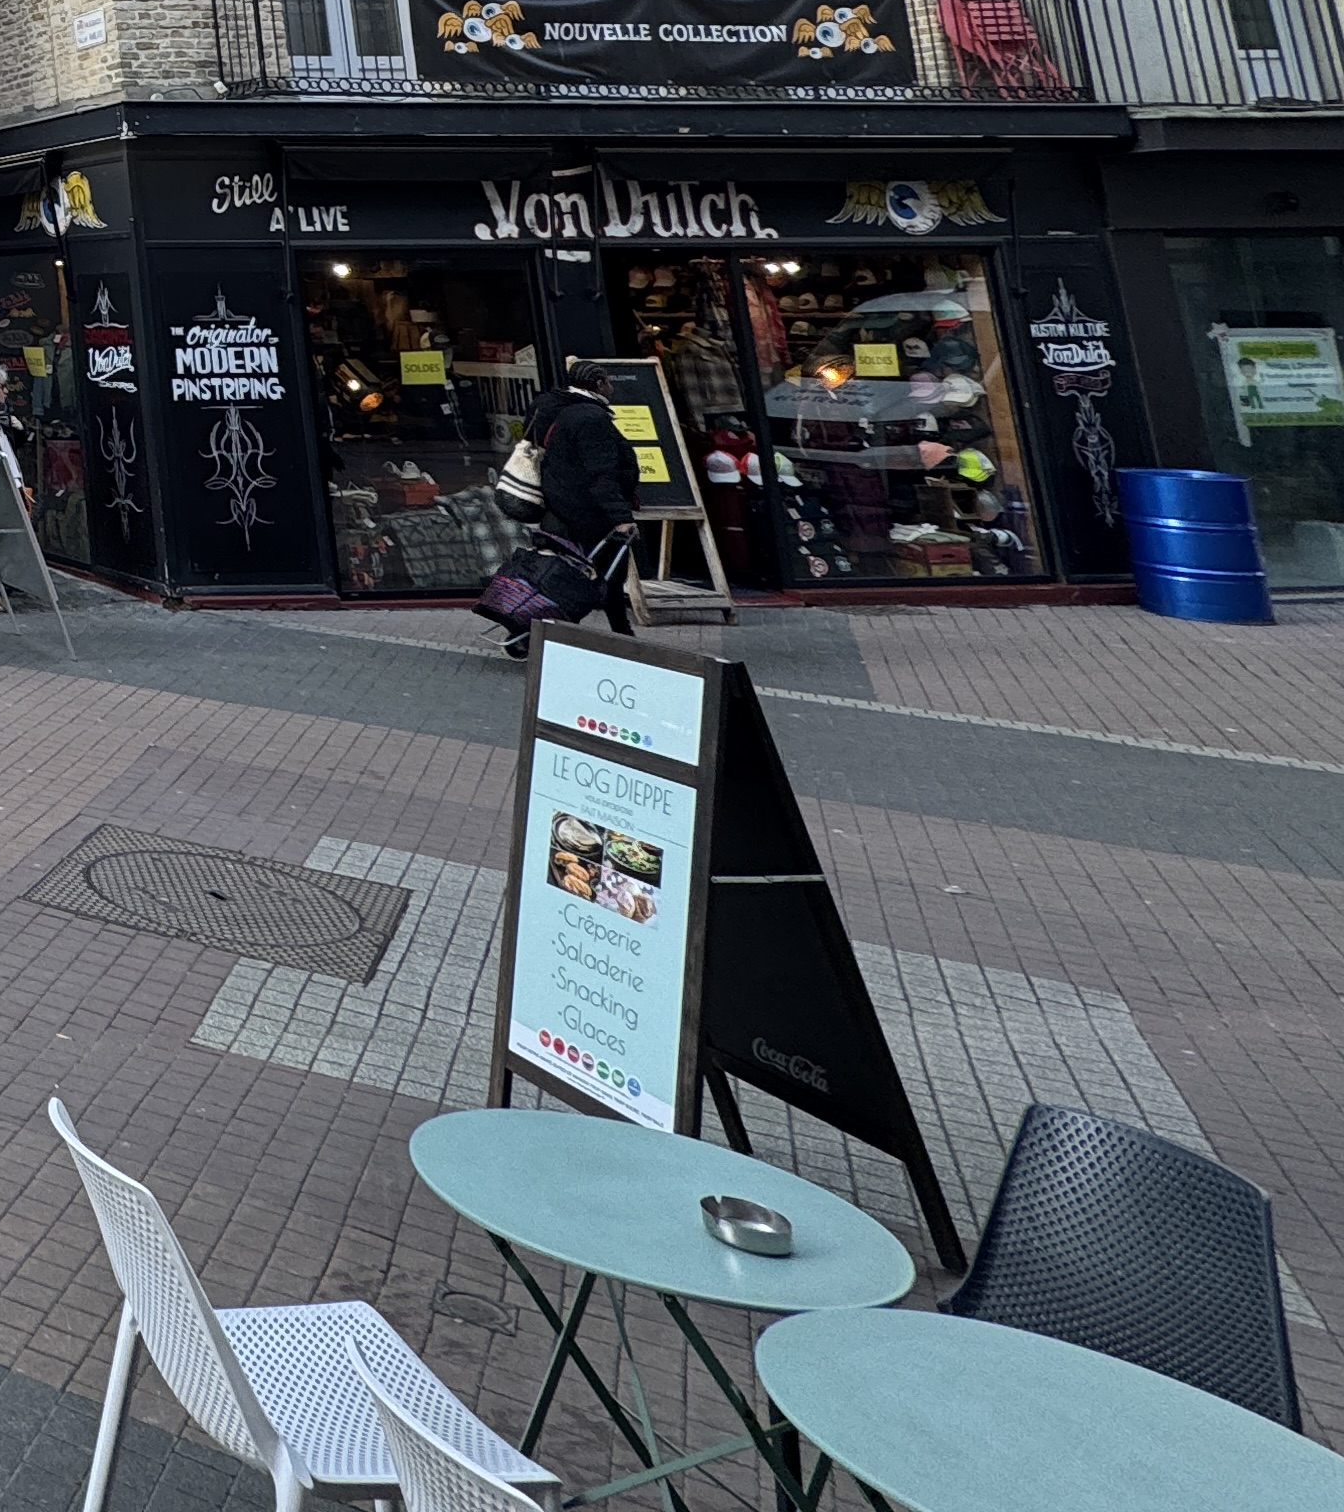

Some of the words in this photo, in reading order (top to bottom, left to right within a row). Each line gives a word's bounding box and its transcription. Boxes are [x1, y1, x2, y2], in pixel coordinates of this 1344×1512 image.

[544, 22, 652, 41] NOUVELLE
[659, 24, 788, 43] COLLECTION
[211, 172, 278, 215] Still
[186, 316, 273, 349] Originator
[175, 346, 279, 375] MODERN
[404, 363, 442, 374] SOLDES
[858, 355, 894, 366] SOLDES
[172, 377, 286, 402] PINSTRIPING
[552, 753, 570, 781] LE
[574, 761, 611, 794] QG
[615, 773, 674, 816] DIEPPE
